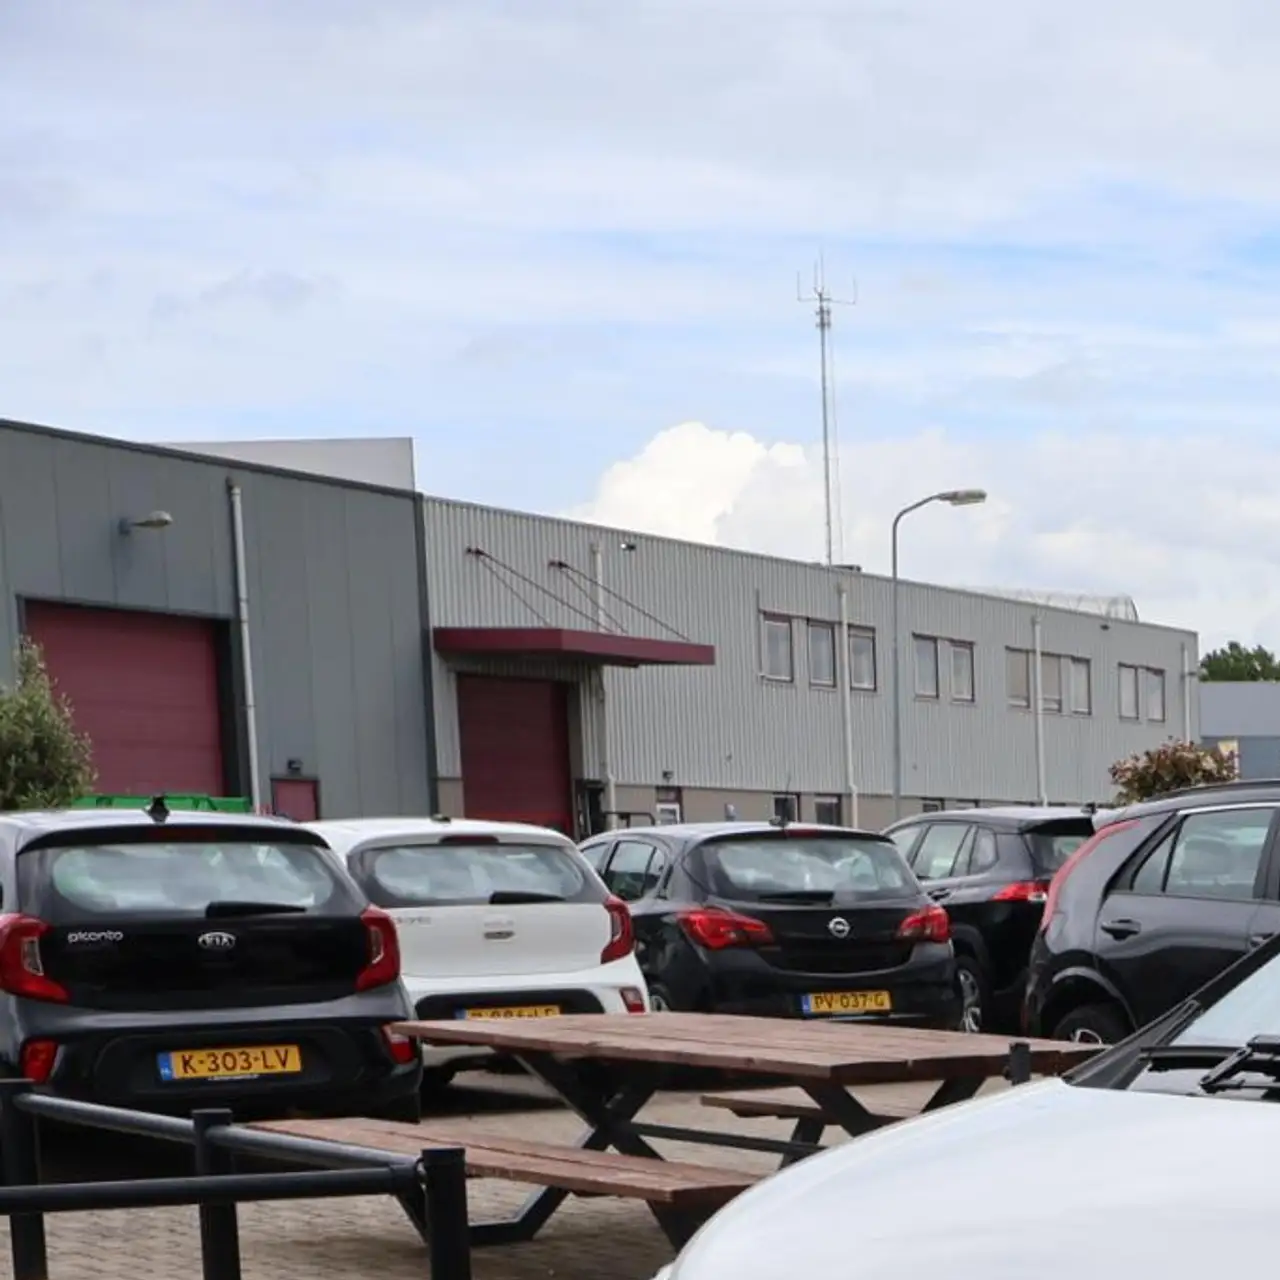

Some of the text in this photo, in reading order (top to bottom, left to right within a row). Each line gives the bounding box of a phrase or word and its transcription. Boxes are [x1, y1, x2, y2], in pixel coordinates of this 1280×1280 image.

[67, 929, 124, 943] picanto
[201, 933, 234, 948] KIA
[181, 1048, 289, 1074] K-303-LV
